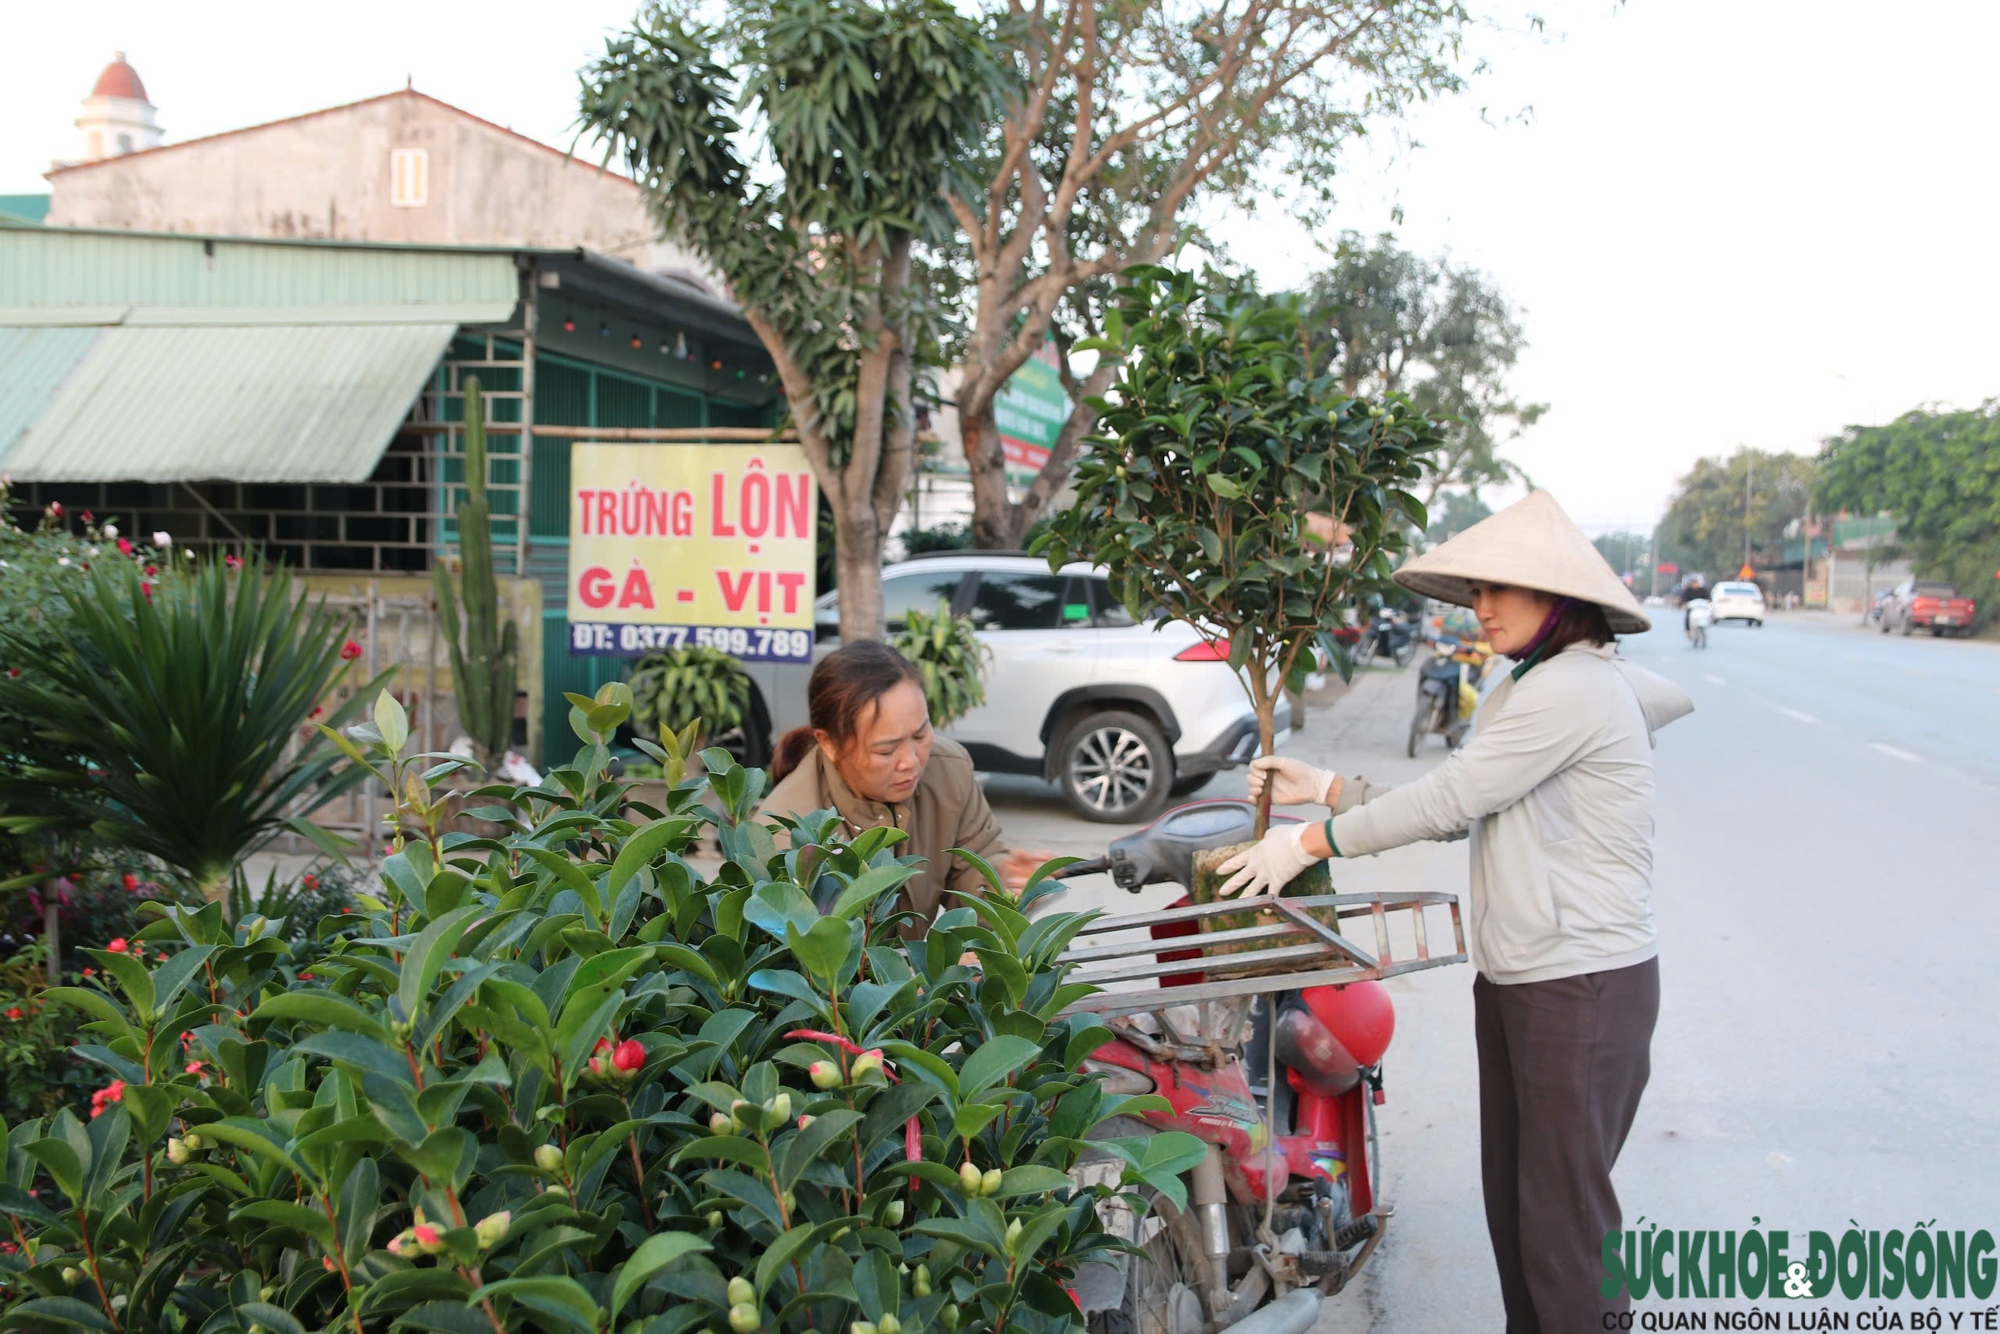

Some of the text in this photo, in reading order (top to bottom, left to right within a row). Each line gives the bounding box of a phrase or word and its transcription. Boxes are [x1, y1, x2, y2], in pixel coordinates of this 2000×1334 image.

[577, 457, 809, 553] TRỨNG LỘN
[578, 558, 805, 624] GÀ - VỊT
[573, 622, 809, 657] ĐT: 0377599.789
